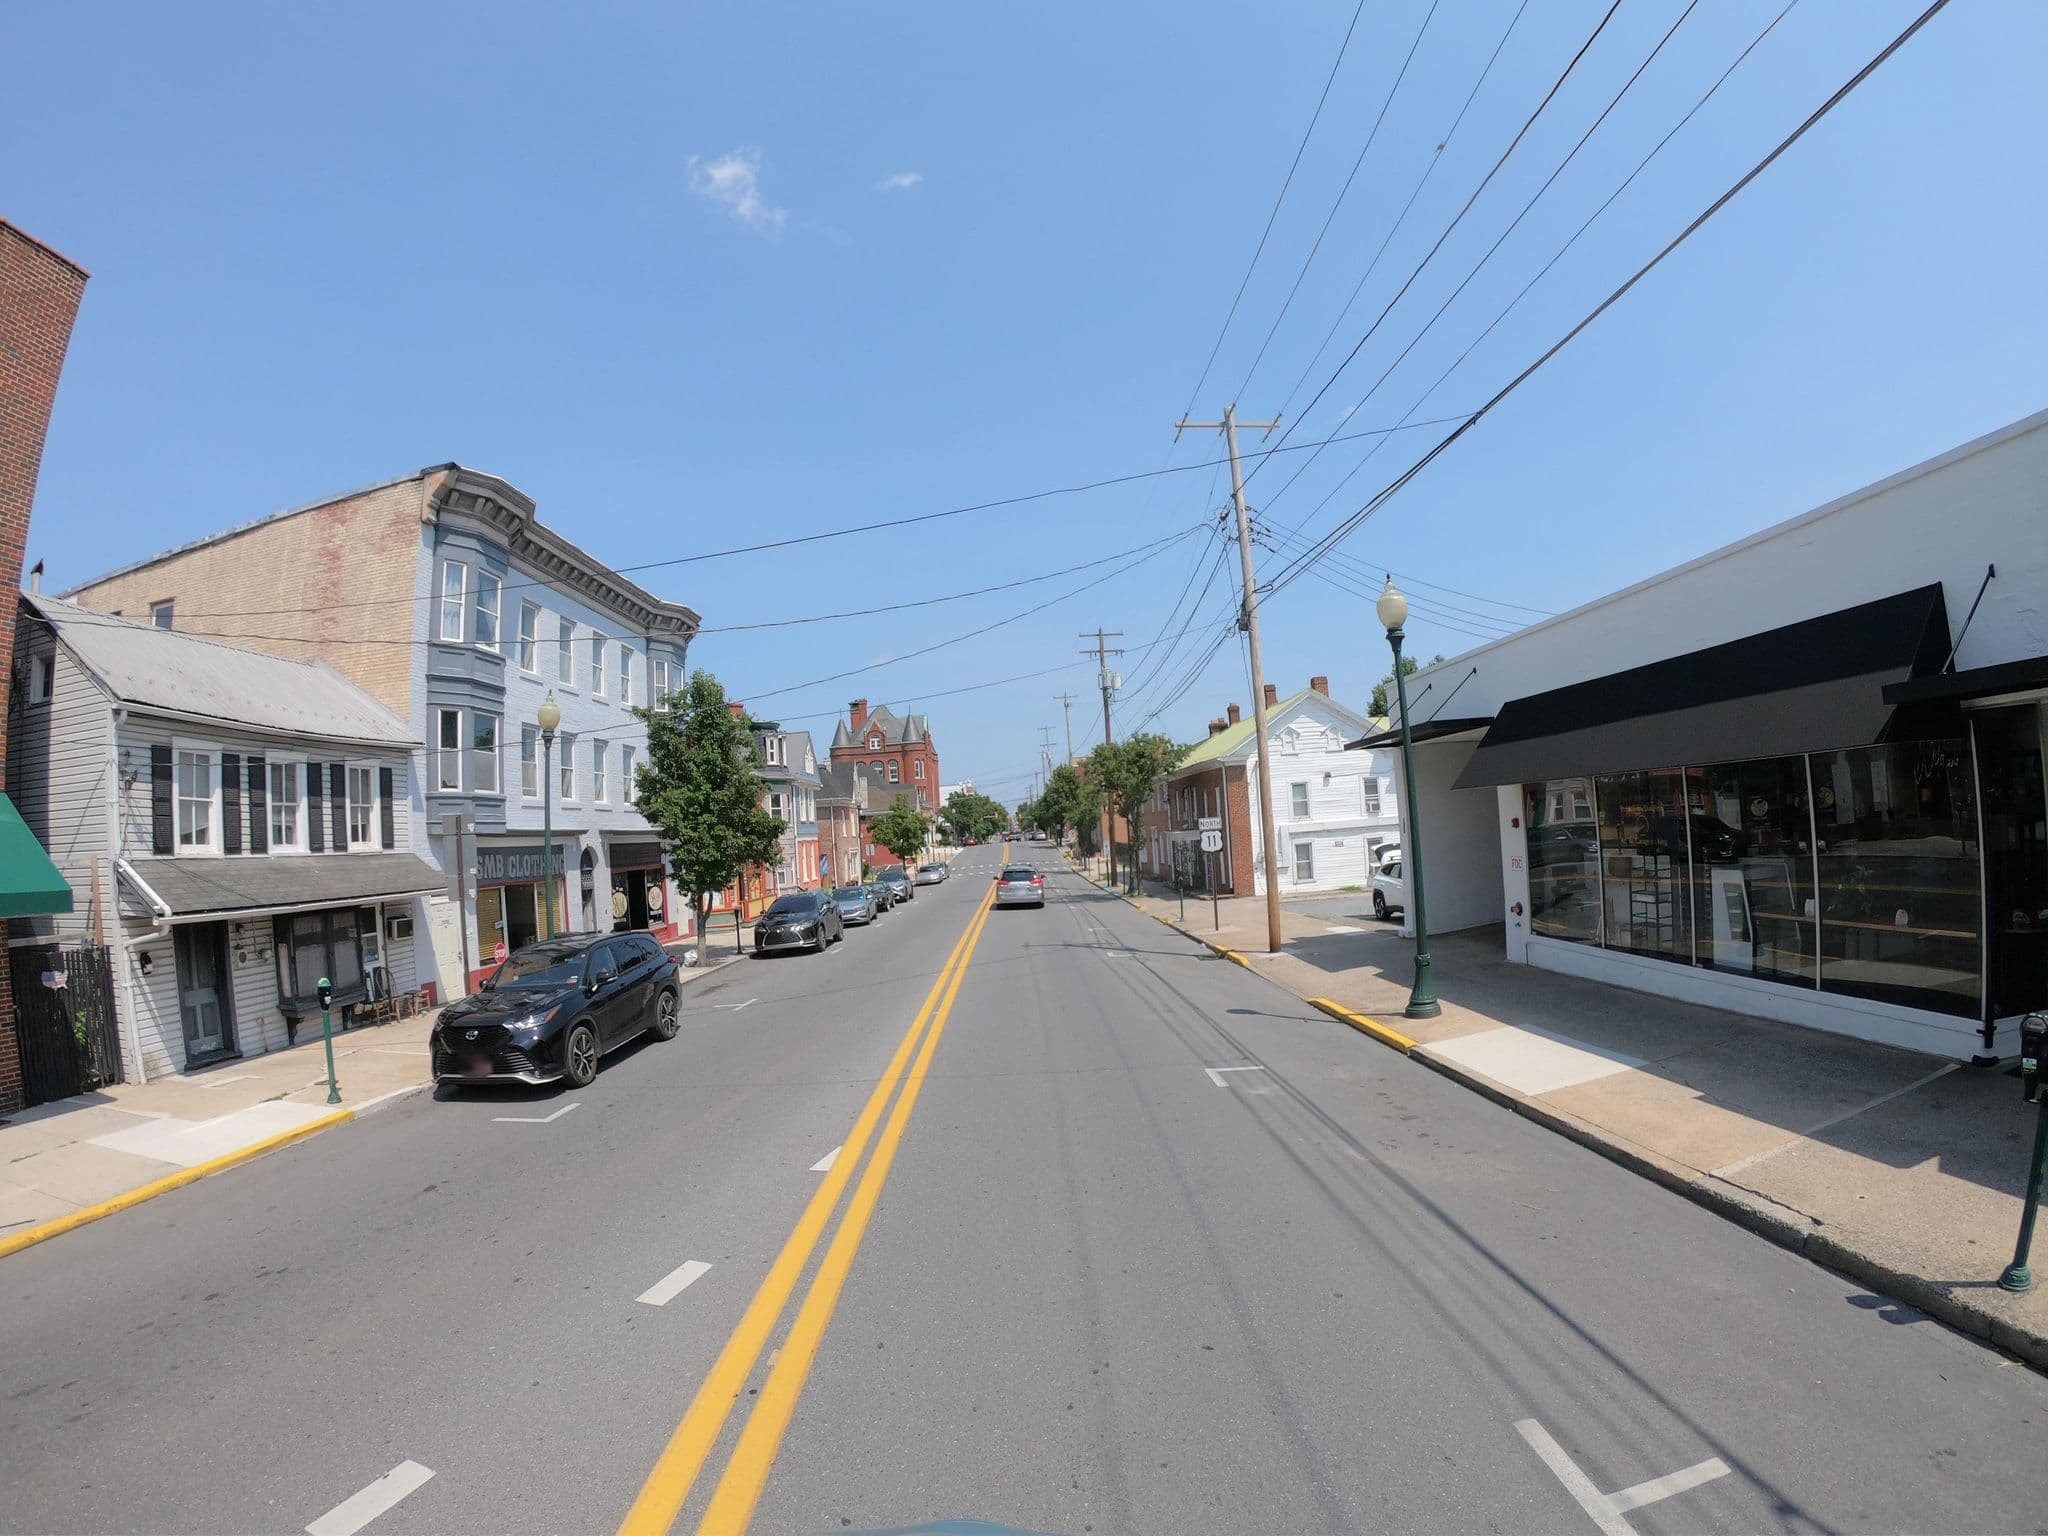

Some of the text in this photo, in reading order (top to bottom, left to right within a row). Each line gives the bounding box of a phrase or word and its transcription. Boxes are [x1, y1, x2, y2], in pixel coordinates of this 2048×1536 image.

[1200, 820, 1221, 828] NORTH
[1207, 835, 1216, 847] 11
[509, 854, 565, 878] CLOTHNG
